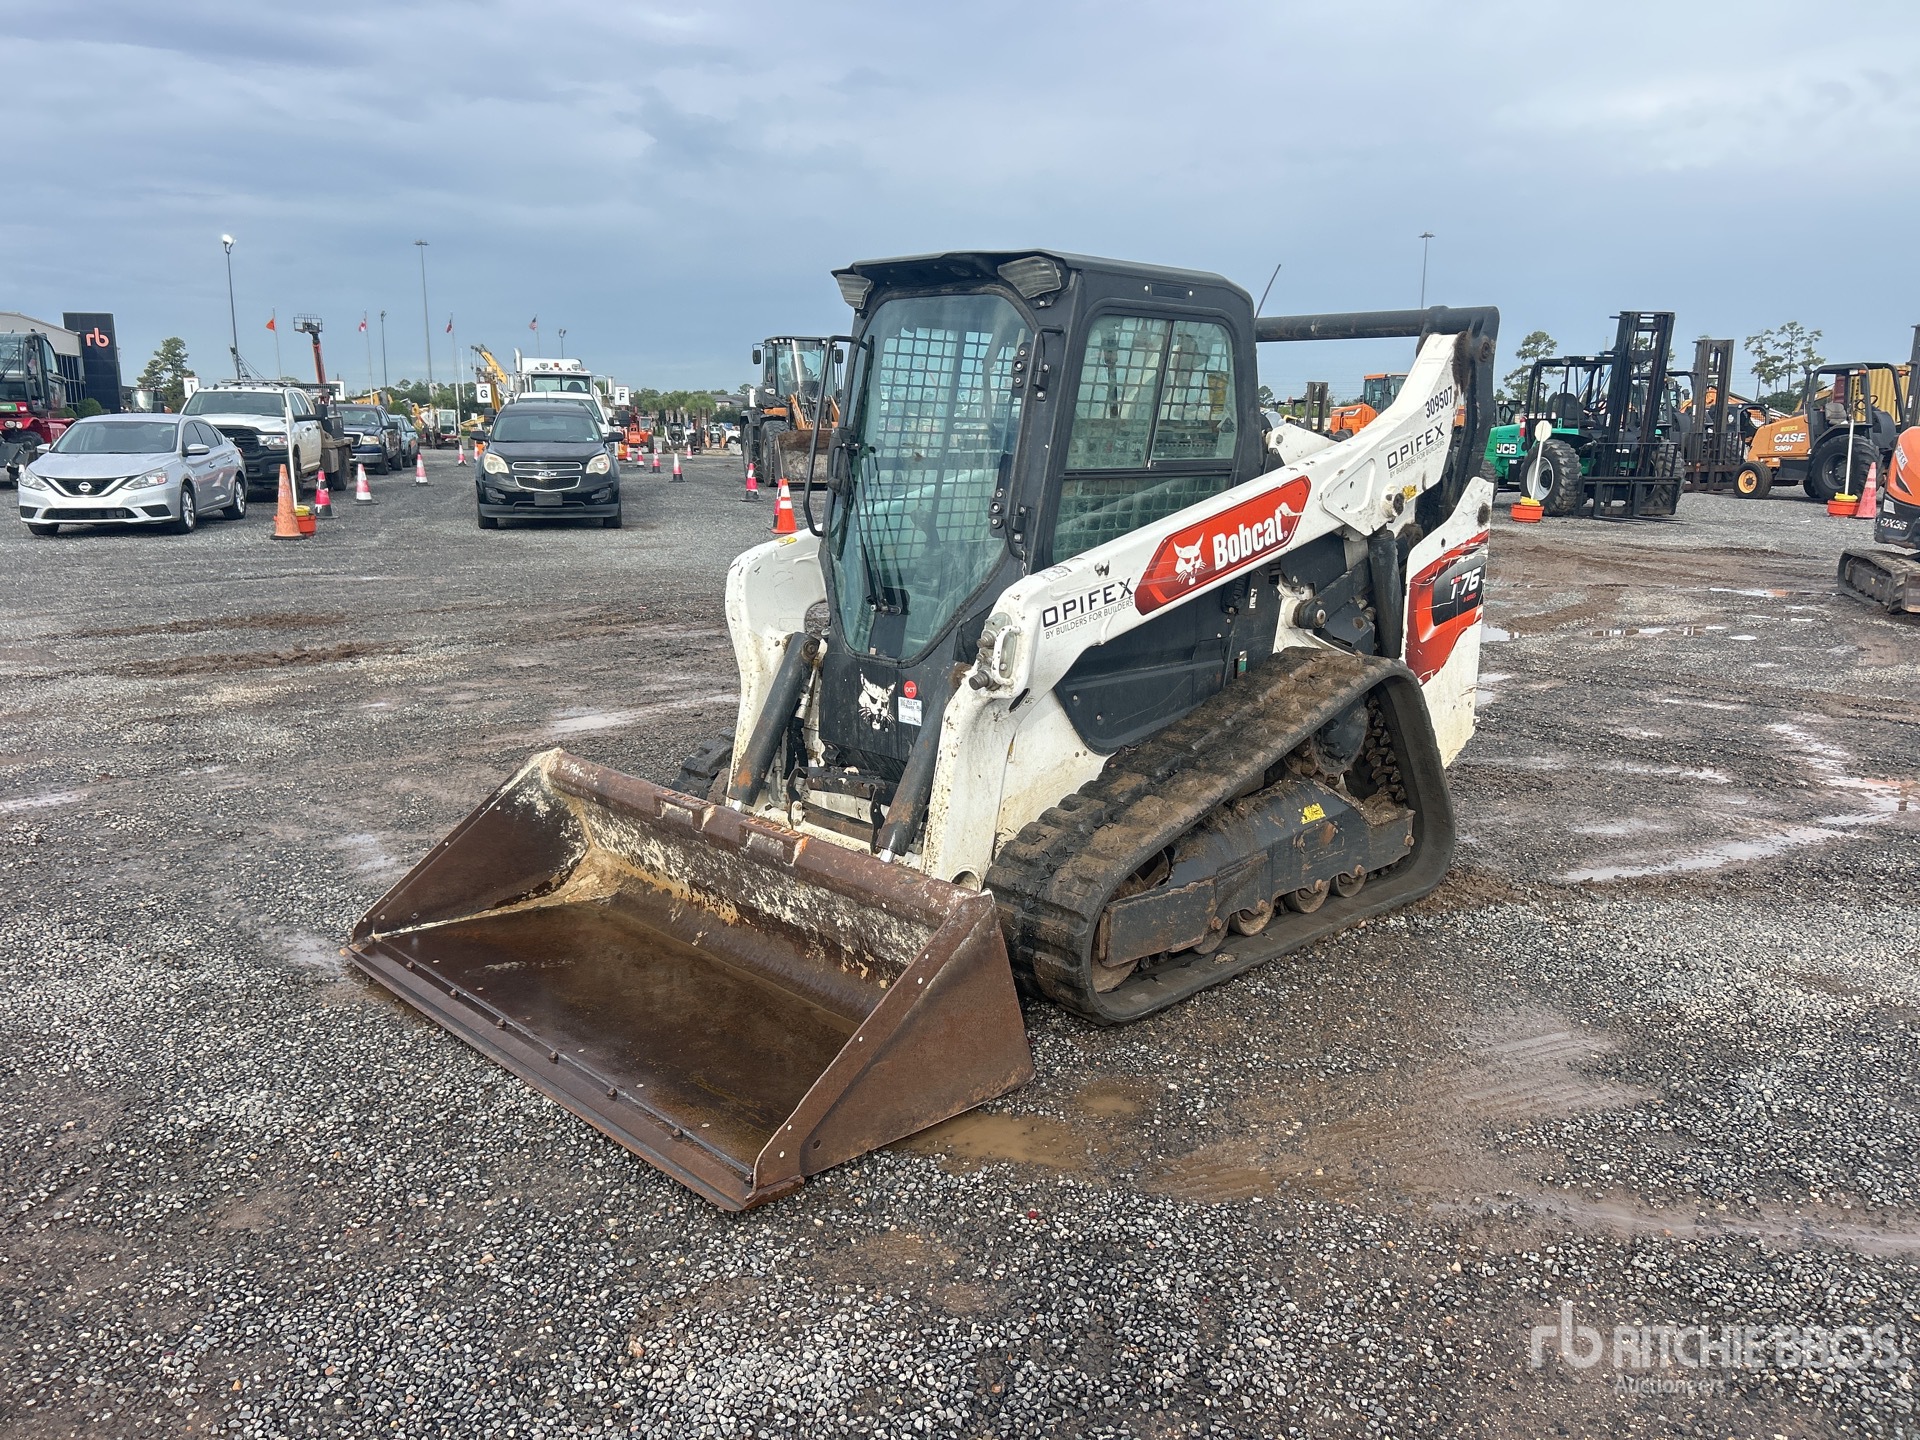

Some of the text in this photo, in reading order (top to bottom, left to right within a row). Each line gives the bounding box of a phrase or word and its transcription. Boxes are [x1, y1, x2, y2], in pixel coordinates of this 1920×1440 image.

[86, 327, 109, 347] rb
[480, 389, 488, 398] G
[619, 392, 625, 401] F
[1425, 385, 1452, 418] 309507
[1387, 422, 1444, 469] OPIFEX
[1496, 443, 1517, 455] JCB
[1773, 432, 1807, 443] CASE
[1212, 508, 1284, 571] Bobcat
[1450, 566, 1482, 600] T76
[1042, 577, 1133, 628] OPIFEX
[1045, 598, 1134, 640] BY BUILDERS FOR BUILDERS
